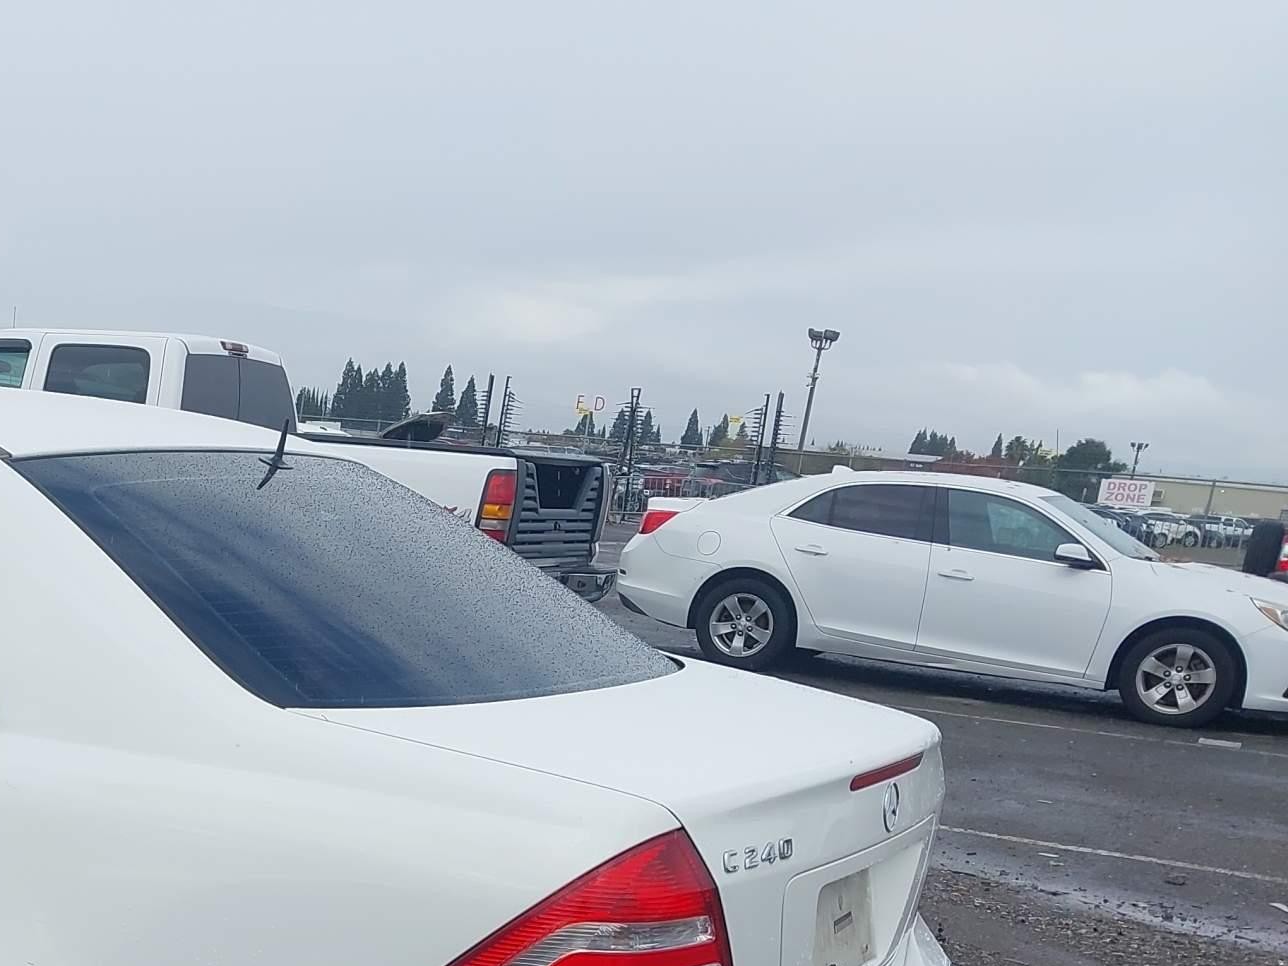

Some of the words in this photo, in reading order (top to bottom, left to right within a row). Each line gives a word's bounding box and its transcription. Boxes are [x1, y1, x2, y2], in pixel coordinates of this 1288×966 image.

[594, 396, 605, 411] D
[1106, 481, 1149, 494] DROP
[1103, 491, 1147, 505] ZONE
